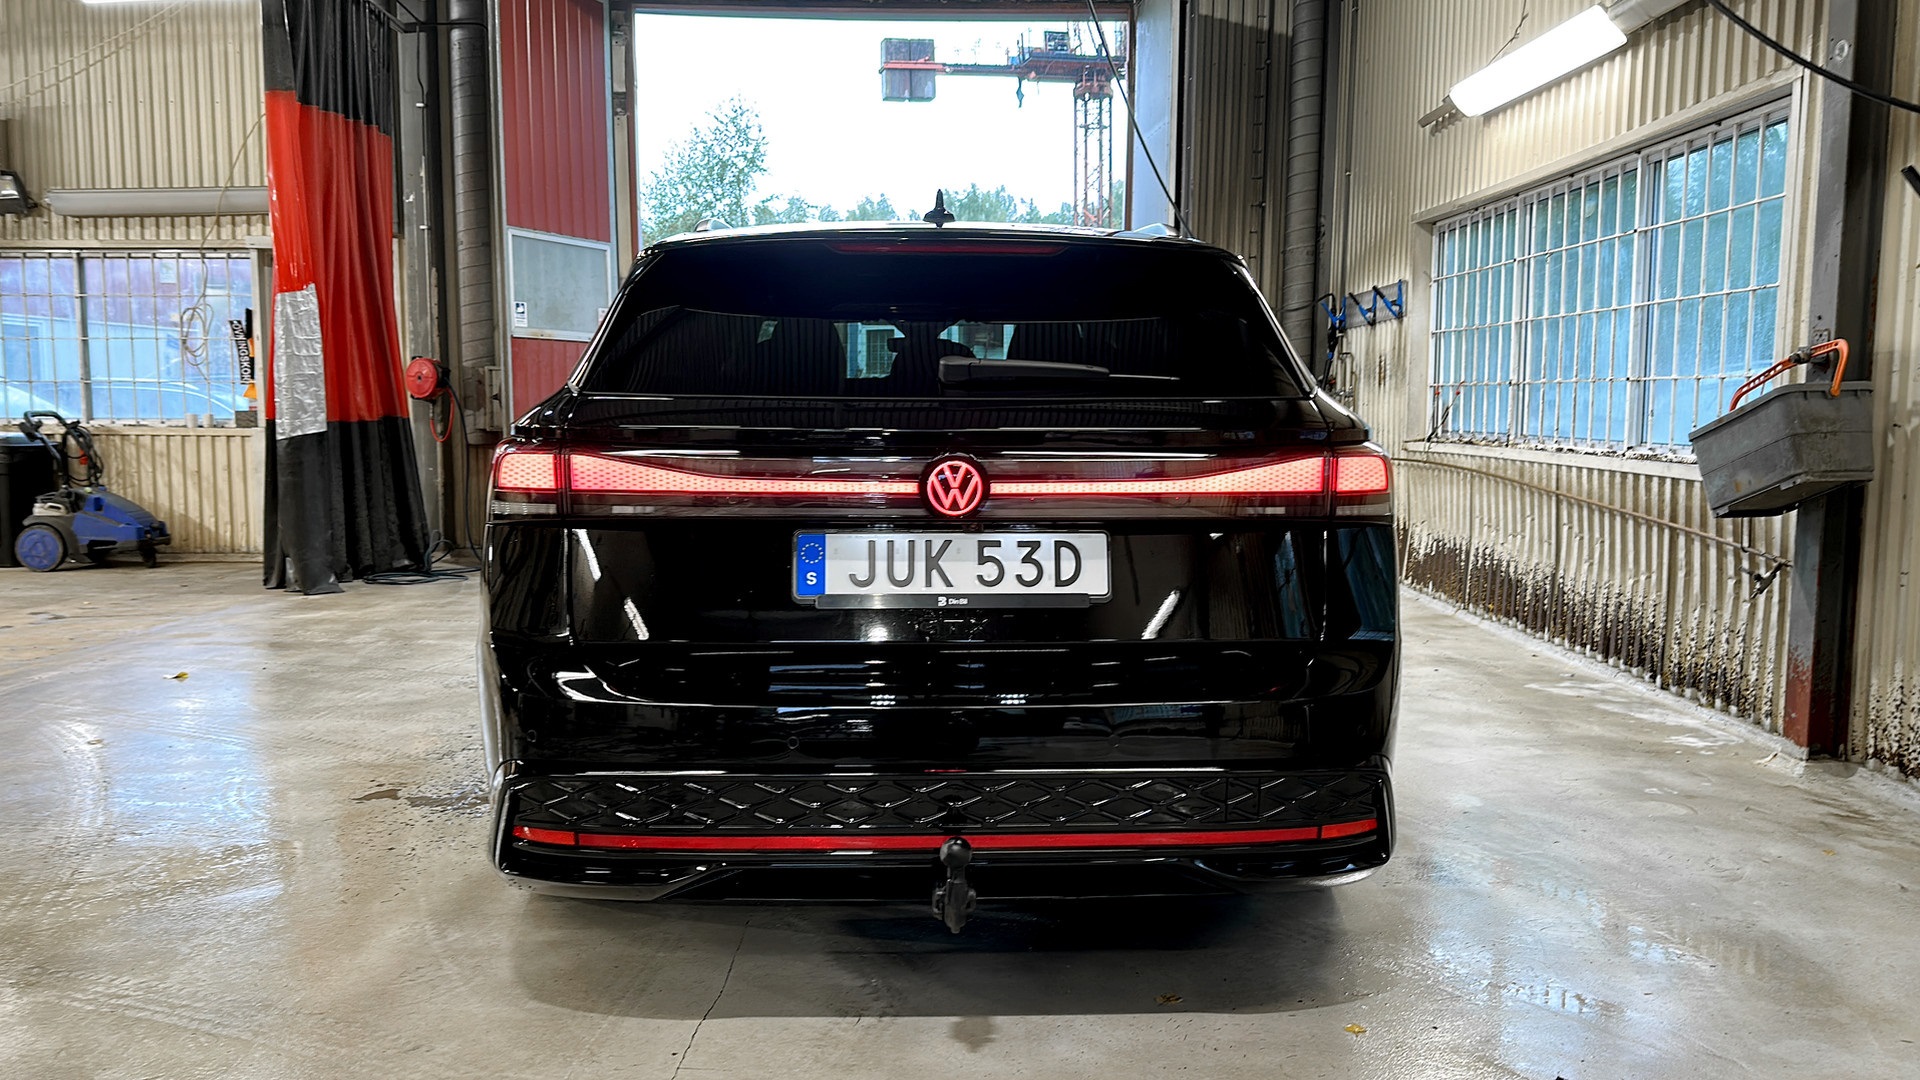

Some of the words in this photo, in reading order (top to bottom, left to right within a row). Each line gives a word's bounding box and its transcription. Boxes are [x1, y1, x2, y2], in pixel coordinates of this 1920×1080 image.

[806, 571, 817, 586] S
[848, 539, 954, 588] JUK
[976, 540, 1082, 588] 53D
